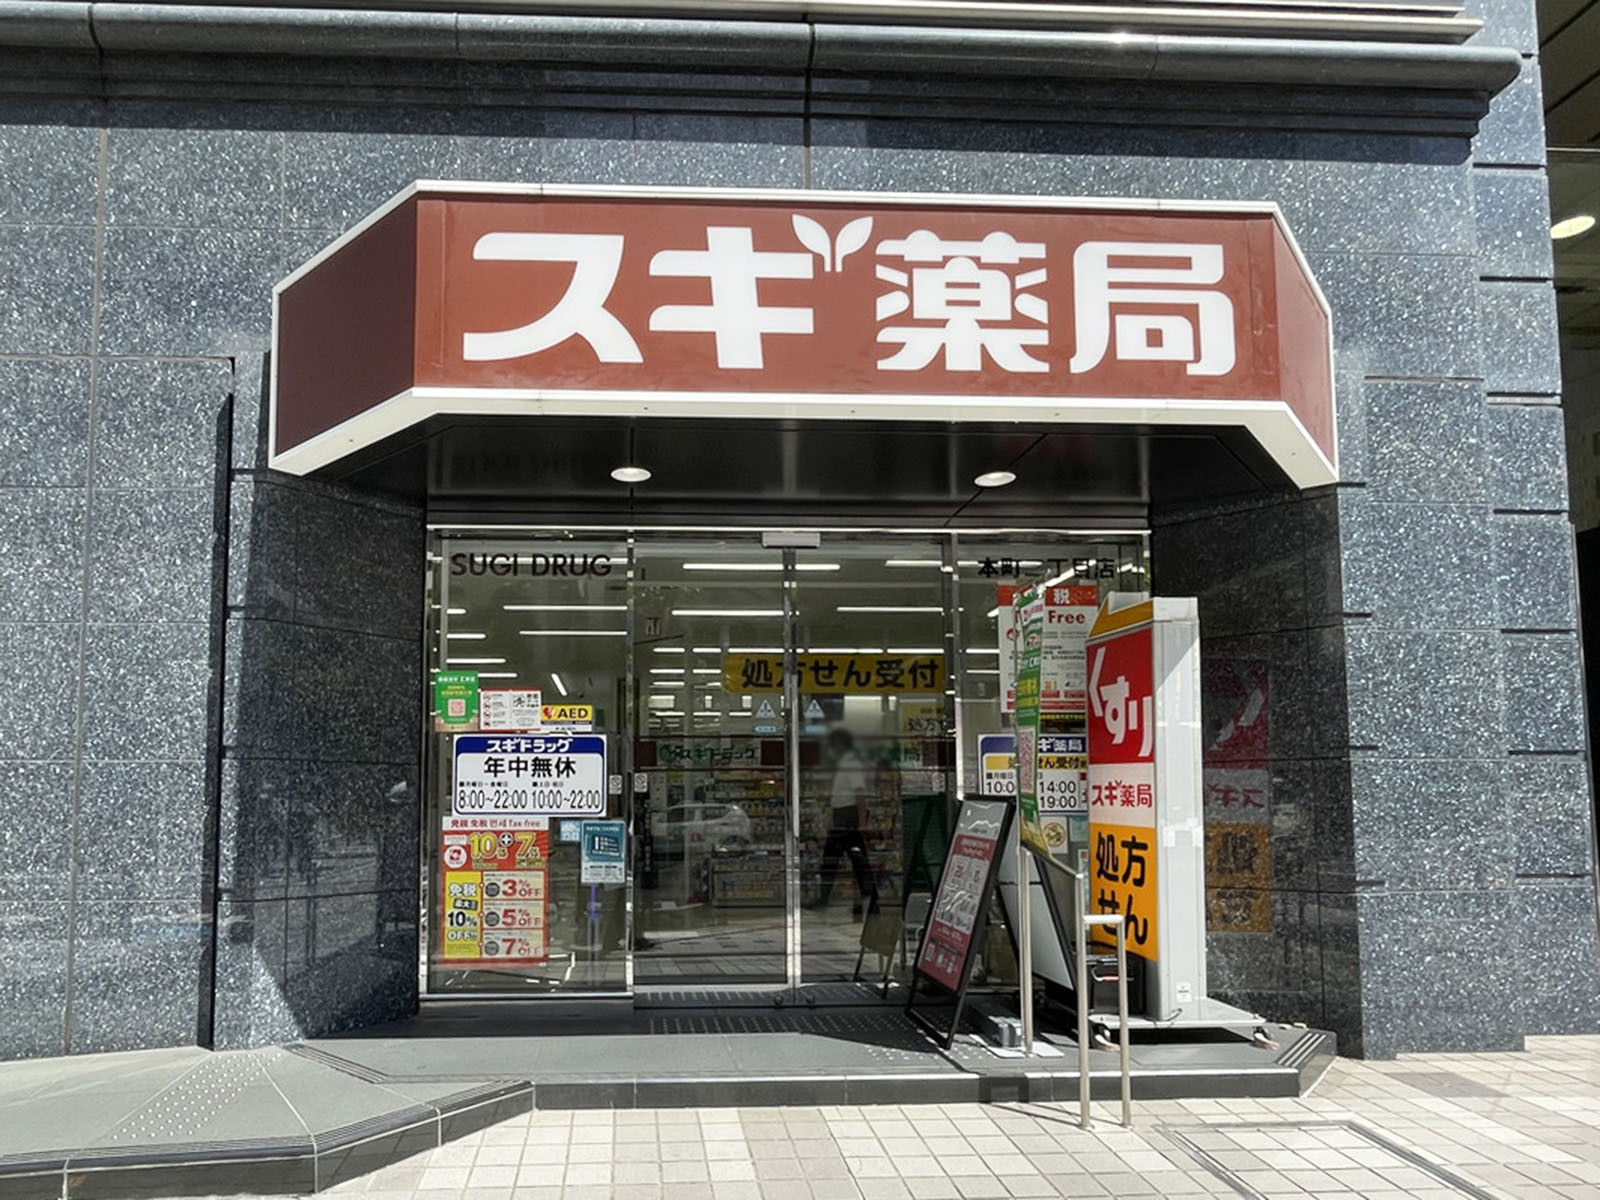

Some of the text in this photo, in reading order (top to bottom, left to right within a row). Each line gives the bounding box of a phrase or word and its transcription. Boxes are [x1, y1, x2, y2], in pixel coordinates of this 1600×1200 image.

[463, 213, 1236, 376] スギ薬局
[451, 553, 612, 577] SUGI DRUG
[1048, 610, 1085, 624] Free
[1088, 646, 1153, 757] くすり
[557, 708, 589, 719] AED
[486, 737, 574, 752] スギドラッグ
[483, 756, 577, 778] 年中無休
[1091, 780, 1153, 808] スギ薬局
[1095, 831, 1149, 887] 処方
[448, 911, 477, 927] 10%
